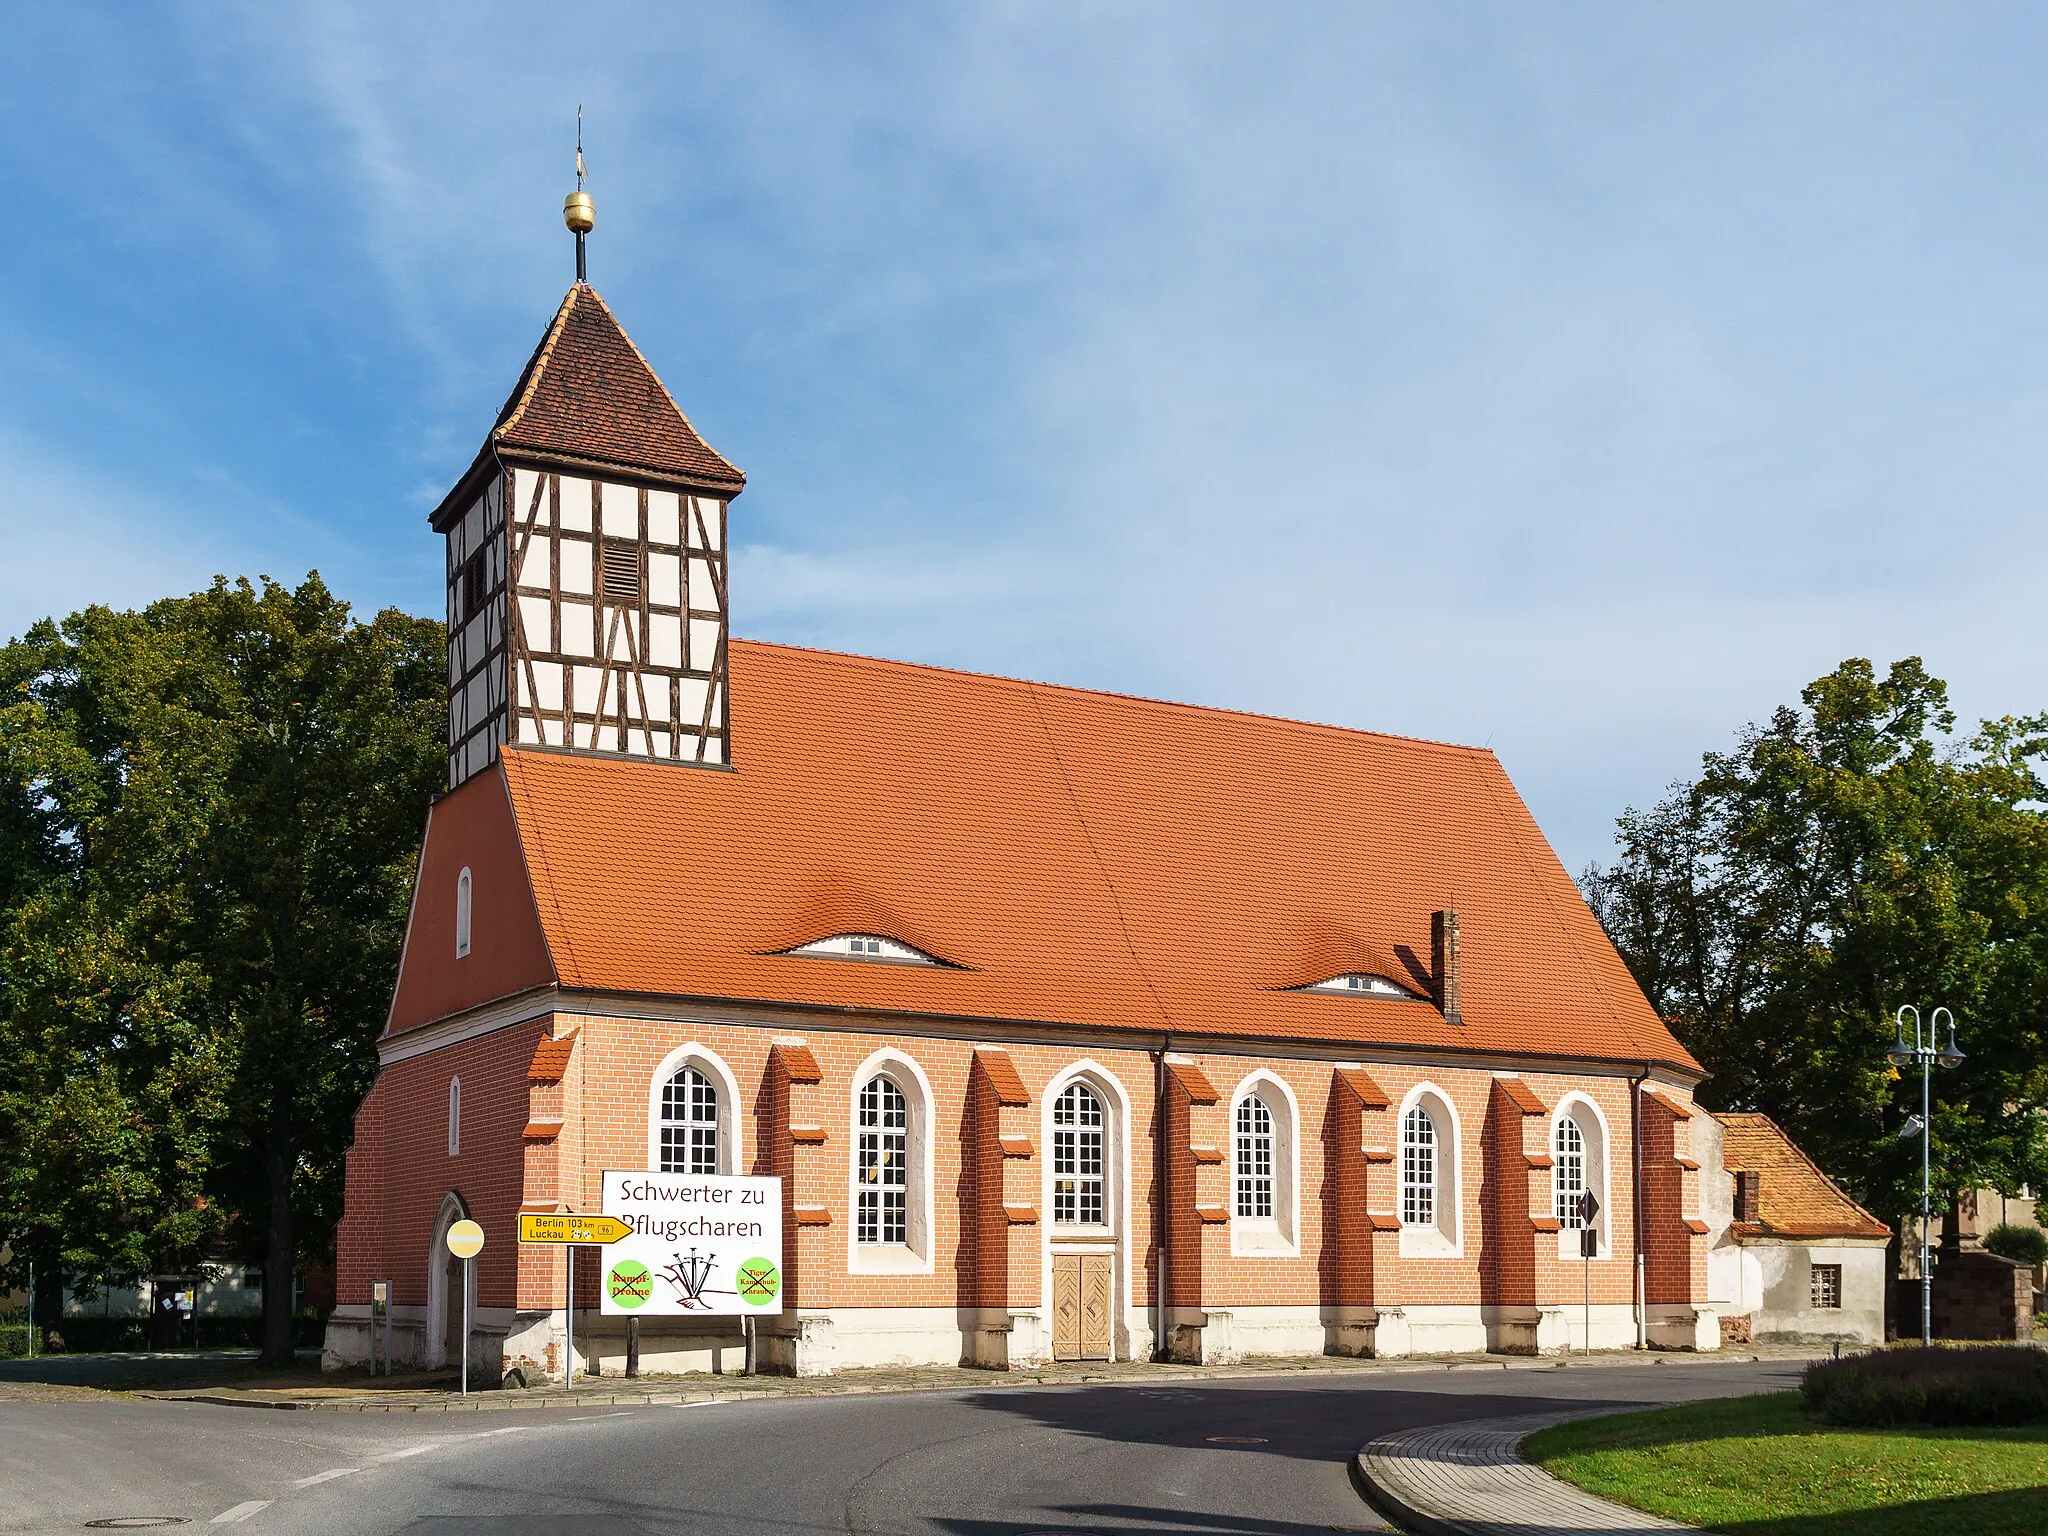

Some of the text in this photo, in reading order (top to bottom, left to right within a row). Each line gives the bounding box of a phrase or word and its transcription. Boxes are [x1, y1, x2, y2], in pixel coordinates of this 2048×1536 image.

[620, 1180, 765, 1205] Schwerter zu
[535, 1218, 595, 1229] Berlin 103 km
[622, 1214, 762, 1242] Pflugscharen
[529, 1229, 564, 1239] Luckau
[612, 1273, 650, 1285] Kampf-
[611, 1286, 650, 1296] Drohne
